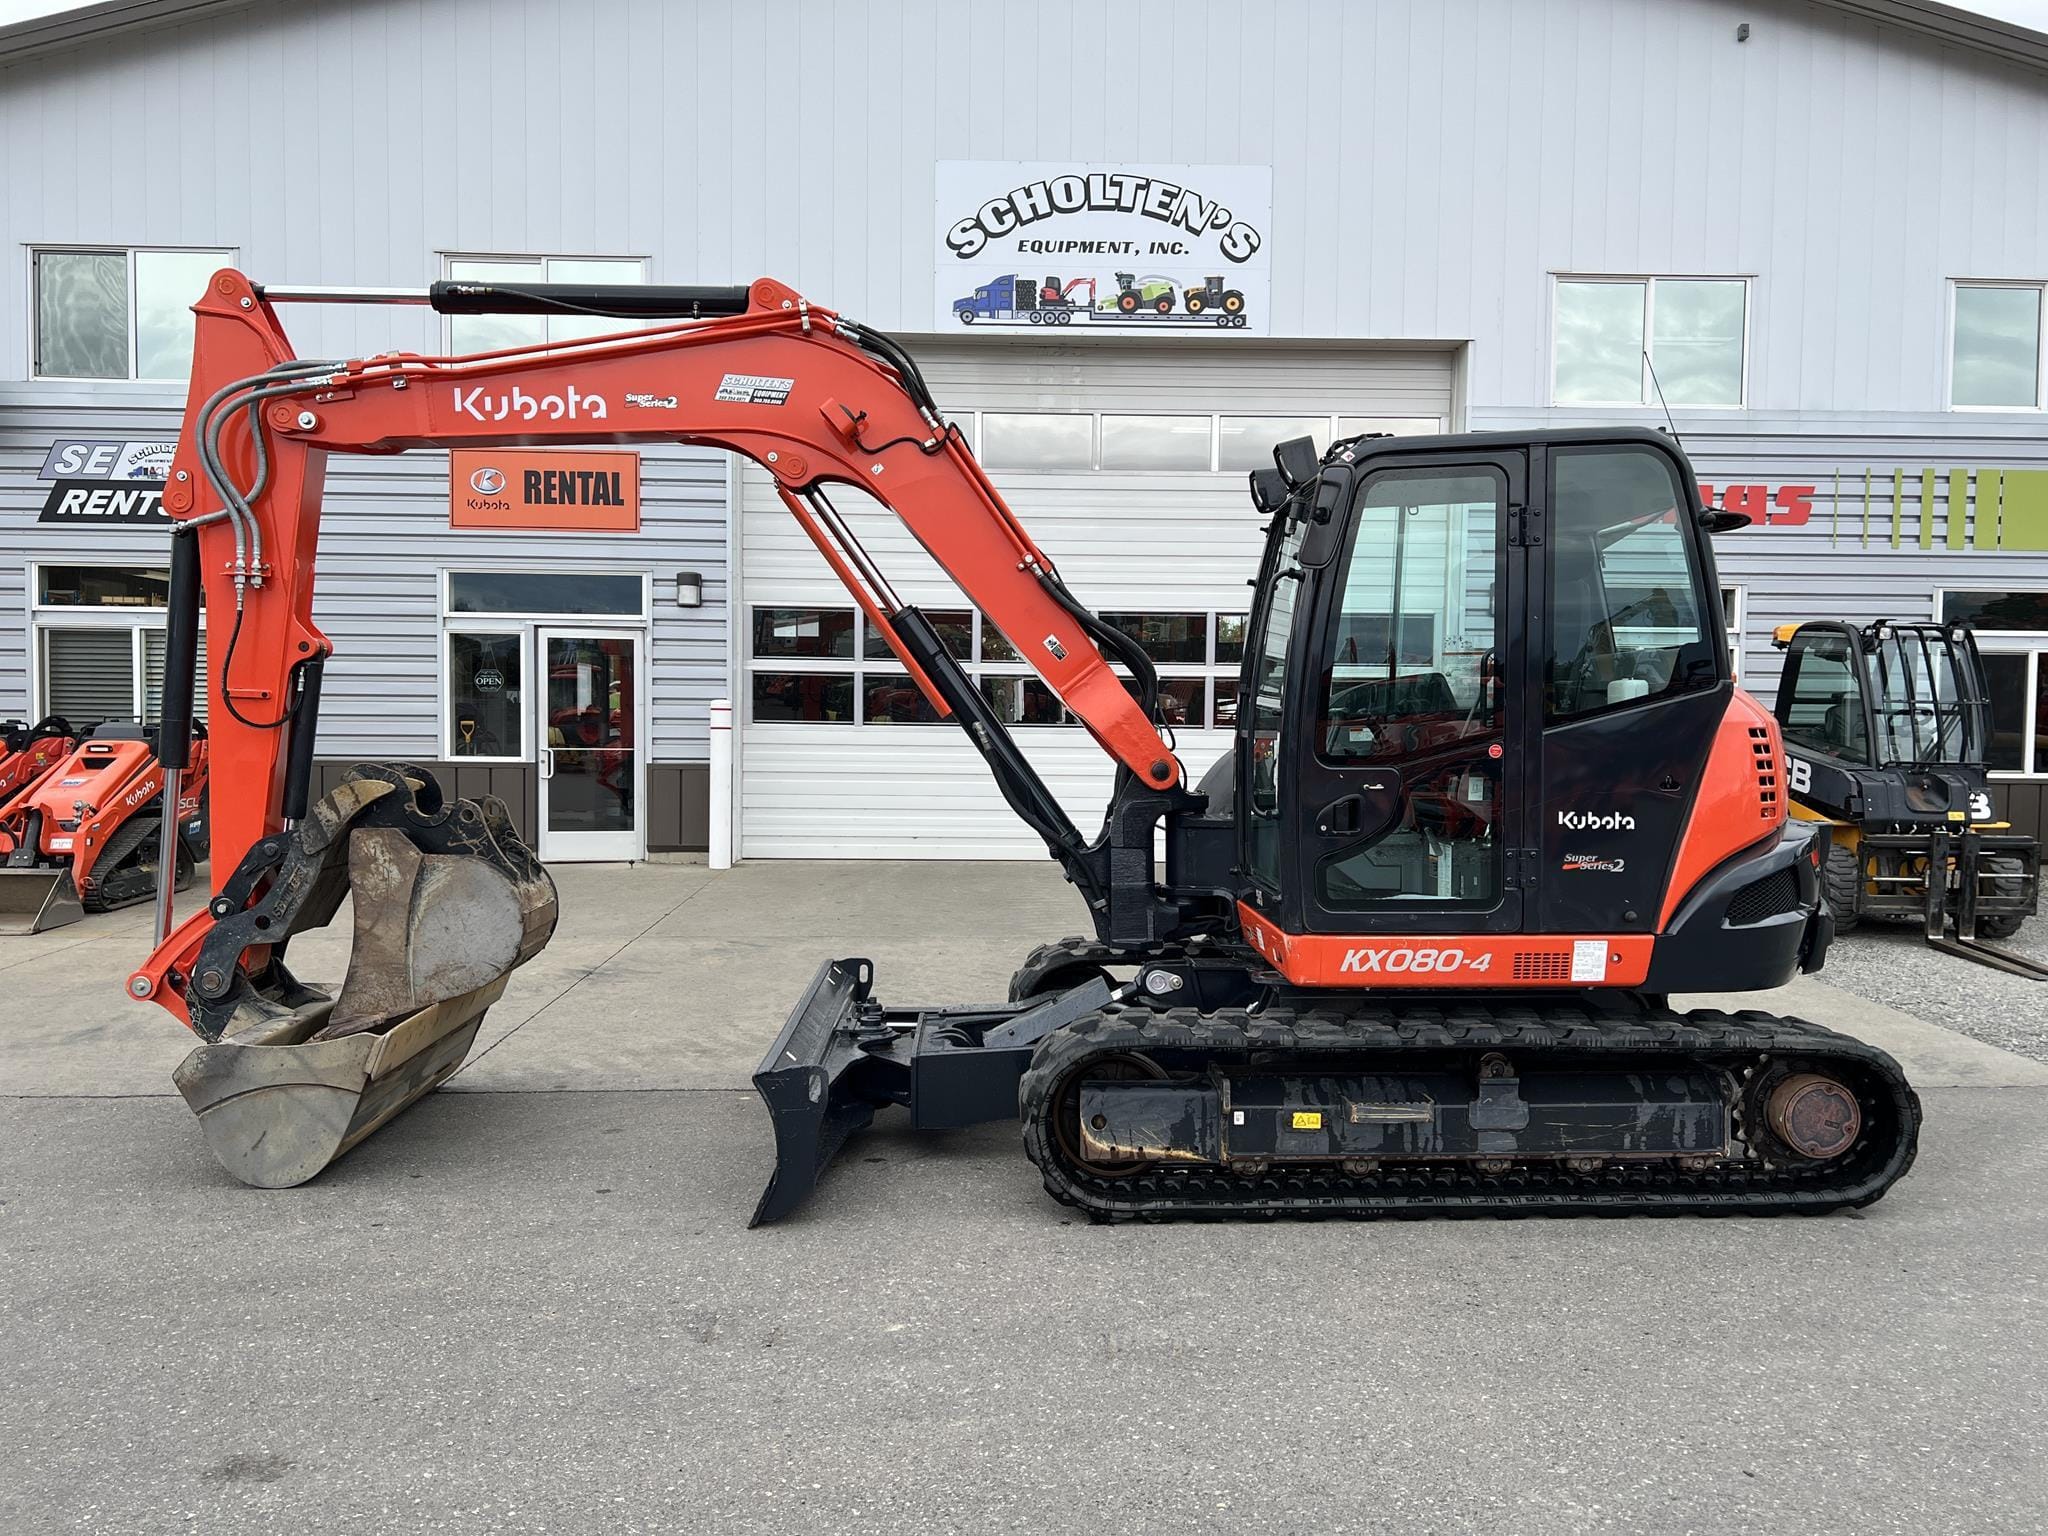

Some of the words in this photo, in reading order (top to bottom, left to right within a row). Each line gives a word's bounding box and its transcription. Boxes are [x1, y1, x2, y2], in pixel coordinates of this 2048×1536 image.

[946, 173, 1261, 263] SCHOLTEN'S
[1017, 239, 1141, 257] EQUIPMENT,
[1148, 240, 1190, 255] INC.
[723, 375, 793, 390] SCHOLTEN'S
[453, 385, 608, 421] Kubota
[624, 393, 655, 403] Super
[54, 444, 120, 475] SE
[523, 470, 625, 507] RENTAL
[467, 498, 510, 510] Kubota
[475, 677, 502, 685] OPEN
[126, 780, 155, 806] Kubota
[1558, 811, 1635, 830] Kubota
[1564, 853, 1598, 864] Super
[1340, 948, 1493, 973] KX080-4
